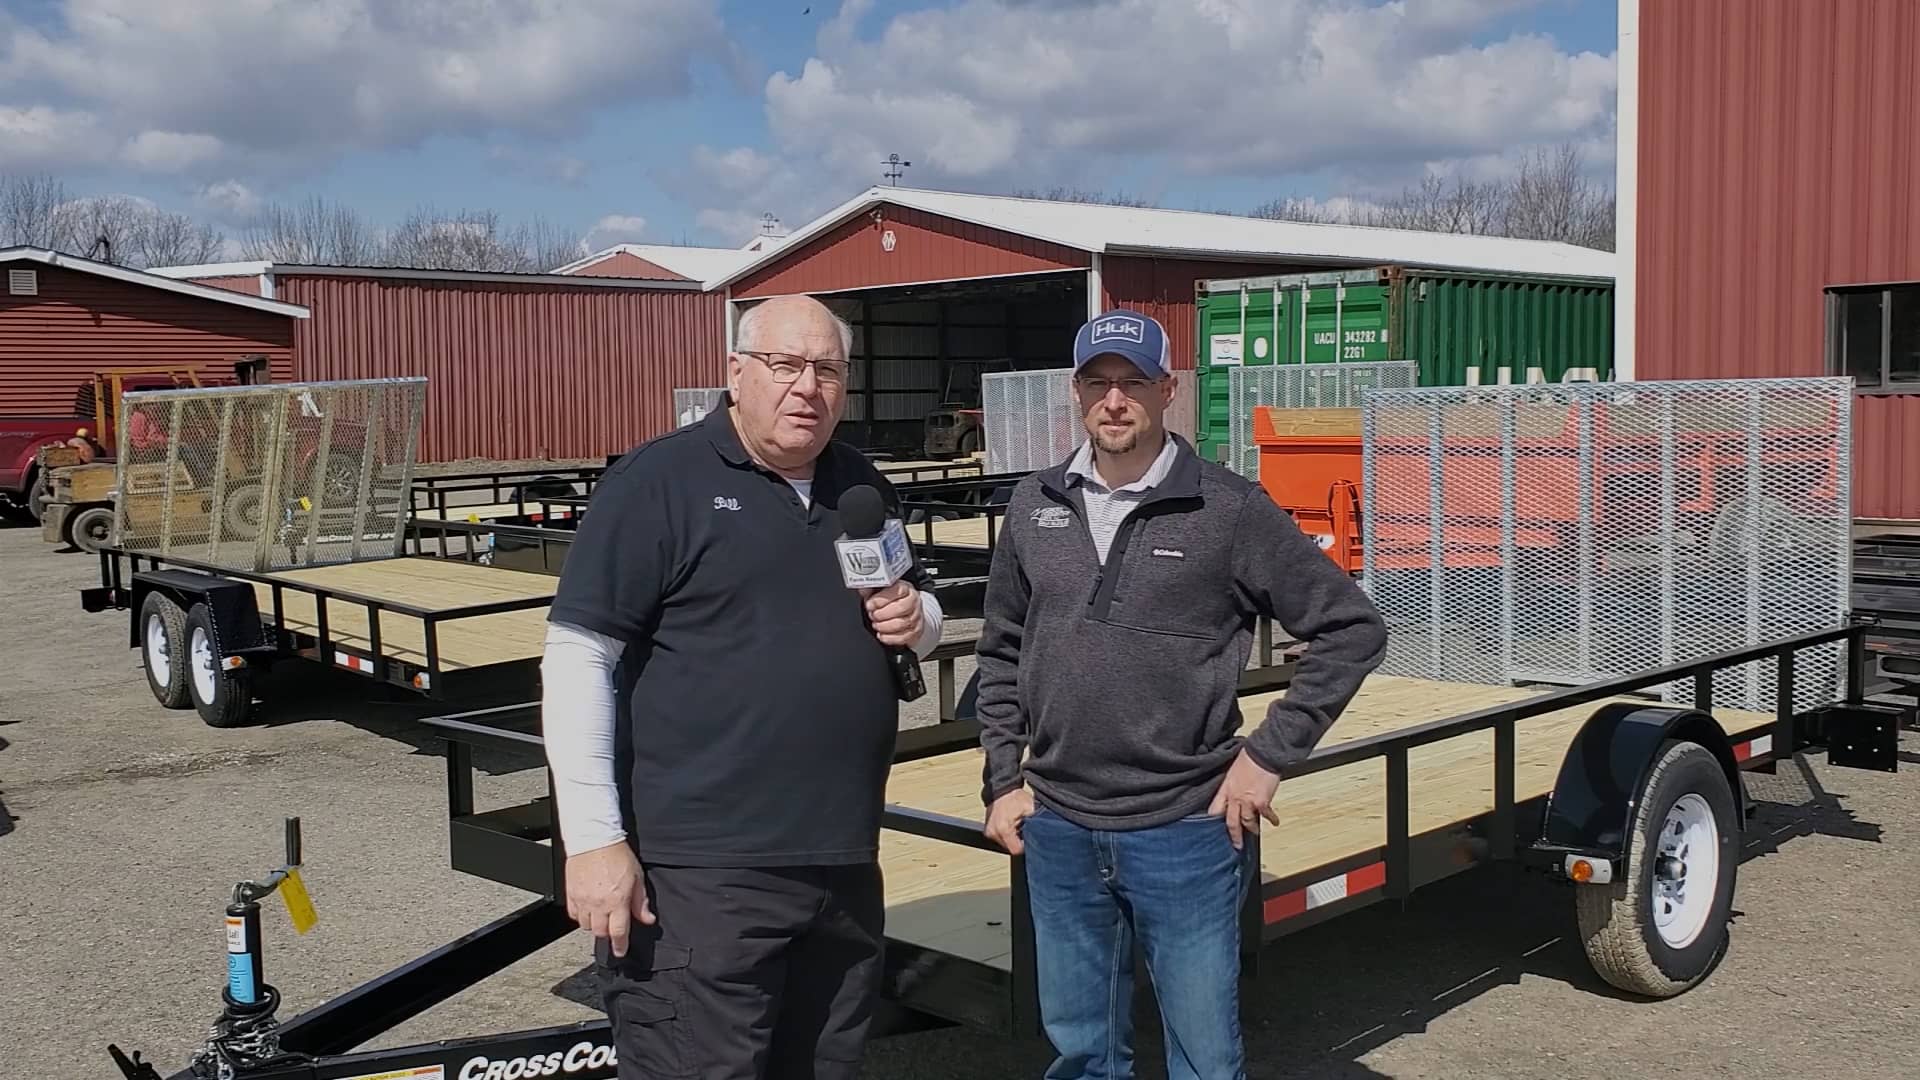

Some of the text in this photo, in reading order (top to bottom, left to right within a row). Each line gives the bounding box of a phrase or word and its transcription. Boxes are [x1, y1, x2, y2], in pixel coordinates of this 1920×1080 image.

[1314, 332, 1336, 345] UACU
[1344, 330, 1376, 343] 343282
[1343, 346, 1365, 359] 22G1
